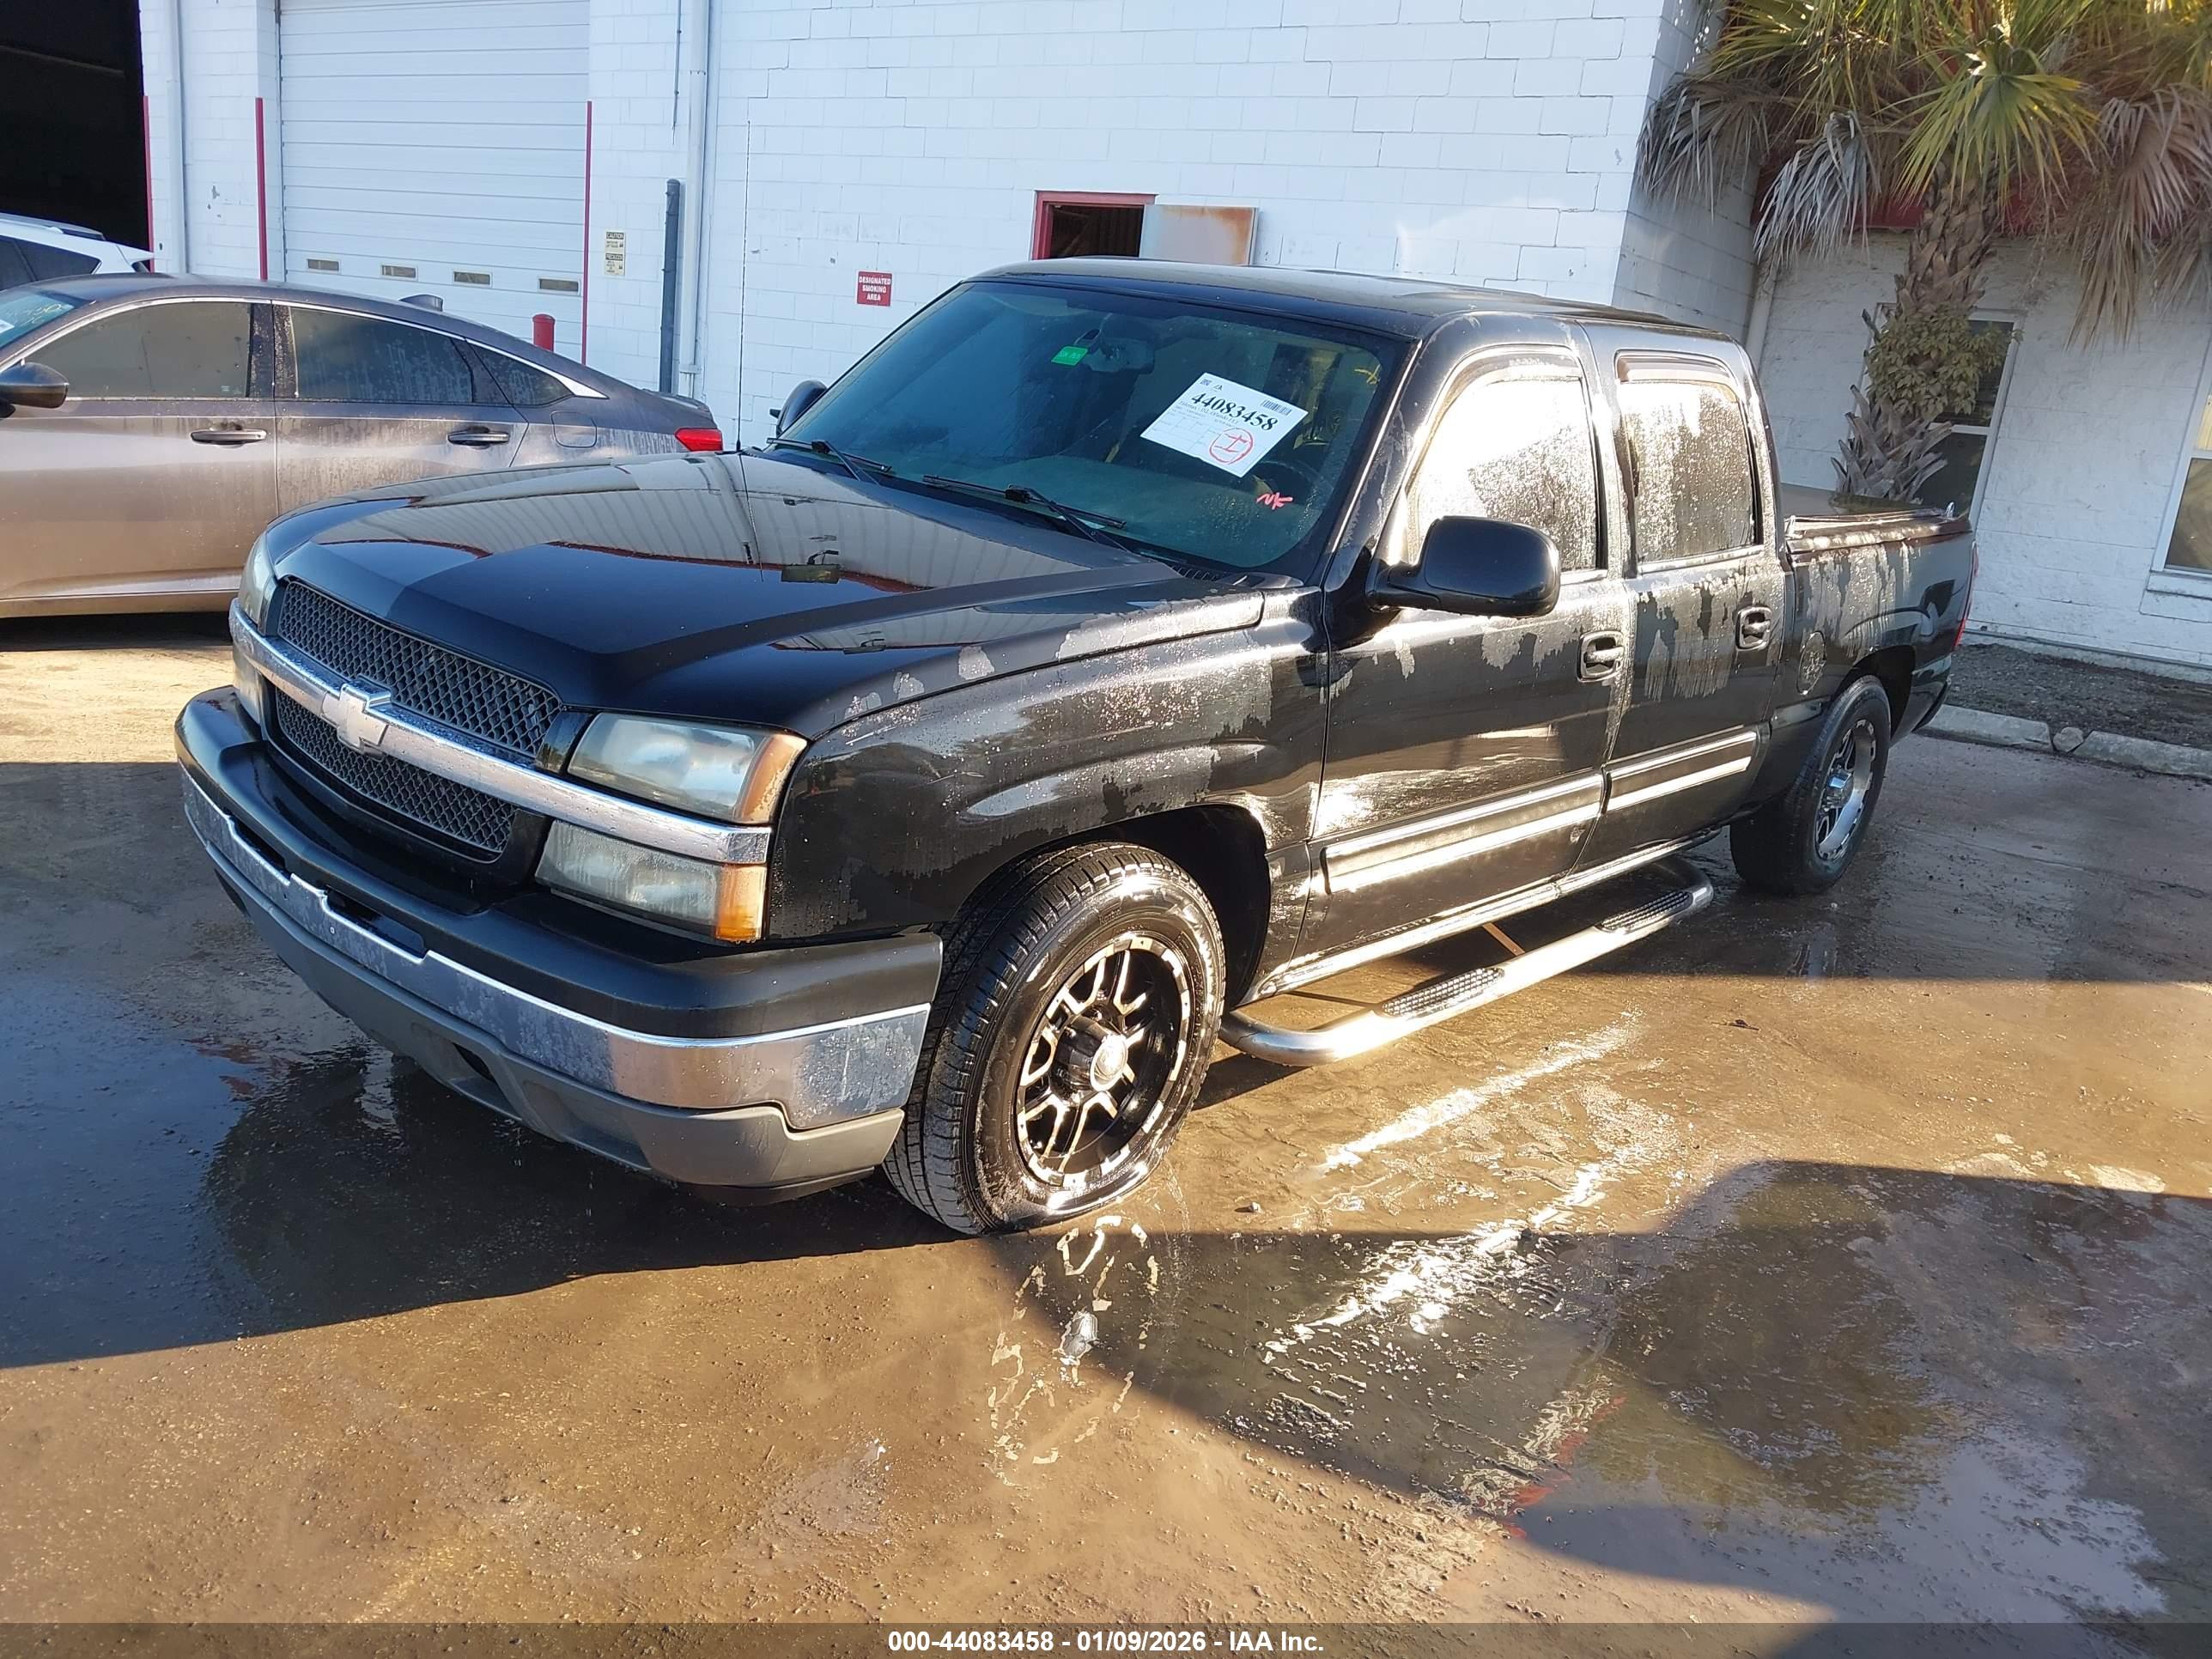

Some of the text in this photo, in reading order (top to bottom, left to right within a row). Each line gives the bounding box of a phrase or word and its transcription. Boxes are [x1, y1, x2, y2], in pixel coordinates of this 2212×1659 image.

[859, 276, 891, 285] DESIGNATED
[862, 284, 887, 294] SMOKING
[866, 293, 882, 301] AREA
[1191, 392, 1279, 431] 44083458
